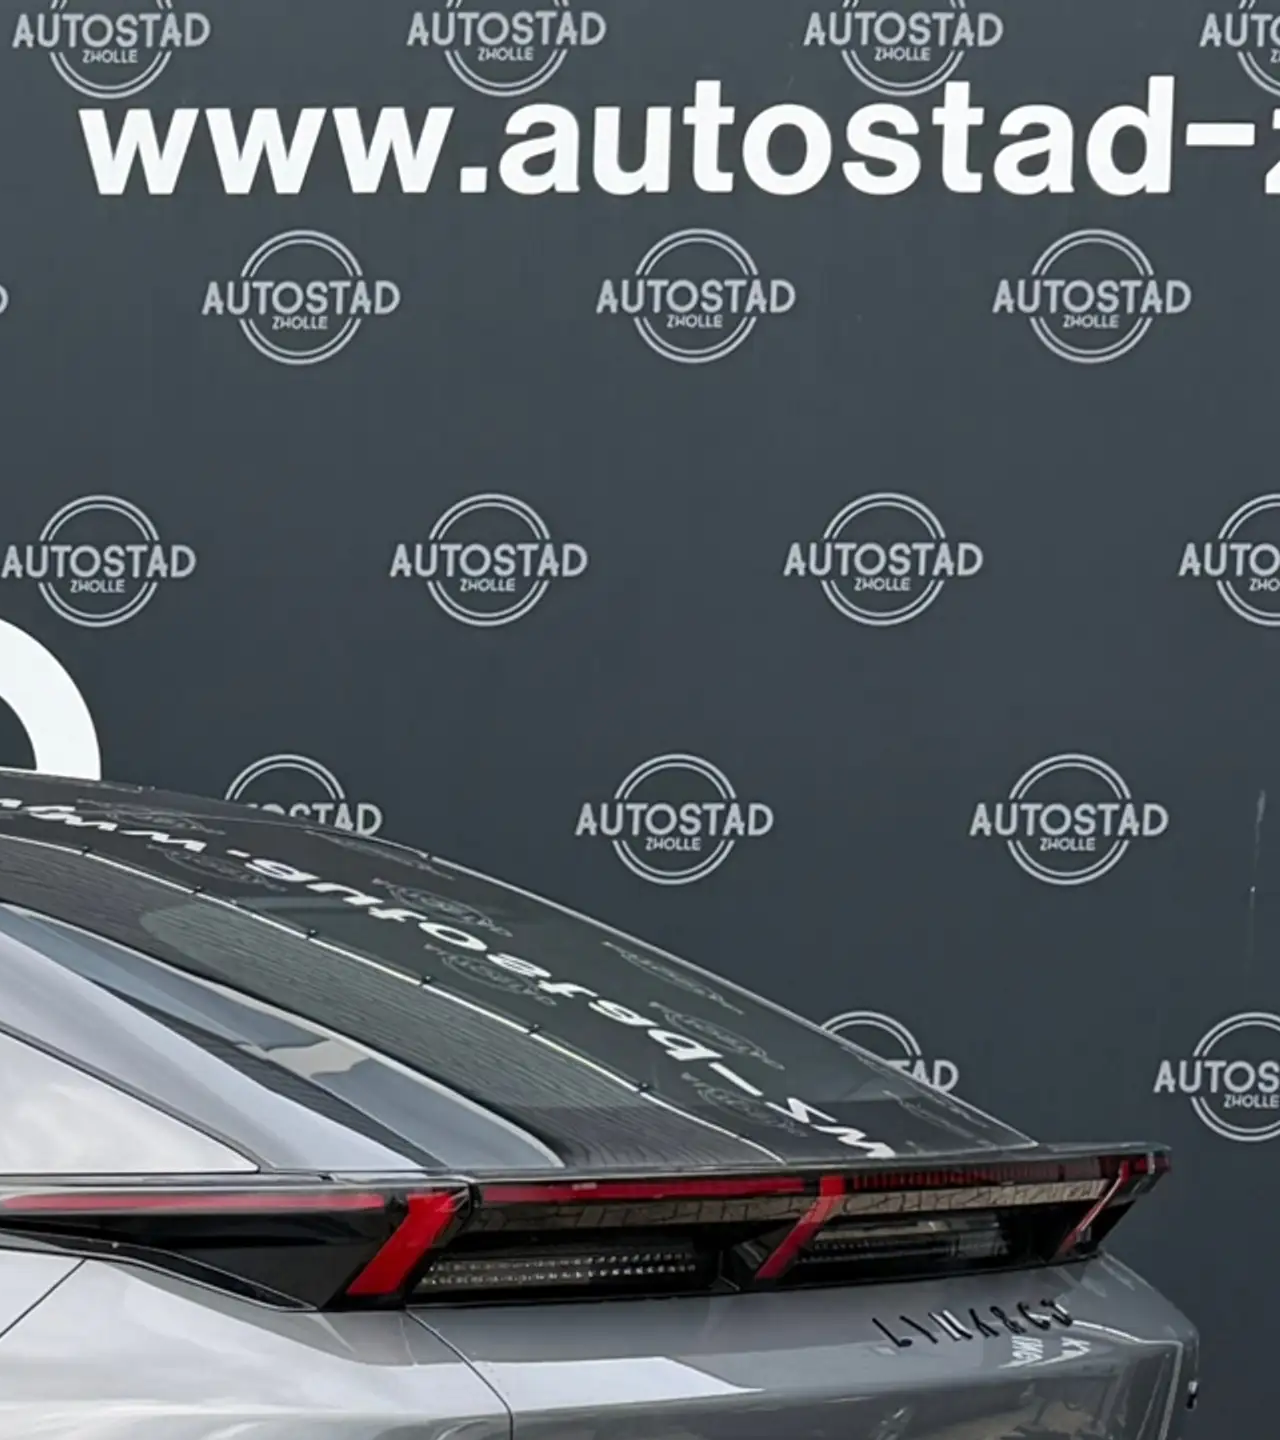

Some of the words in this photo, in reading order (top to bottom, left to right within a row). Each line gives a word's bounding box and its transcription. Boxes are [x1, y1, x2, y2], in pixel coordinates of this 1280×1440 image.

[12, 12, 210, 48] AUTOSTAD
[407, 11, 606, 46] AUTOSTAD
[804, 12, 1003, 47] AUTOSTAD
[202, 280, 400, 315] AUTOSTAD
[596, 279, 796, 314] AUTOSTAD
[992, 279, 1191, 314] AUTOSTAD
[1, 545, 196, 578] AUTOSTAD
[390, 543, 587, 577] AUTOSTAD
[784, 542, 983, 576] AUTOSTAD
[575, 803, 774, 836] AUTOSTAD
[970, 803, 1169, 836] AUTOSTAD
